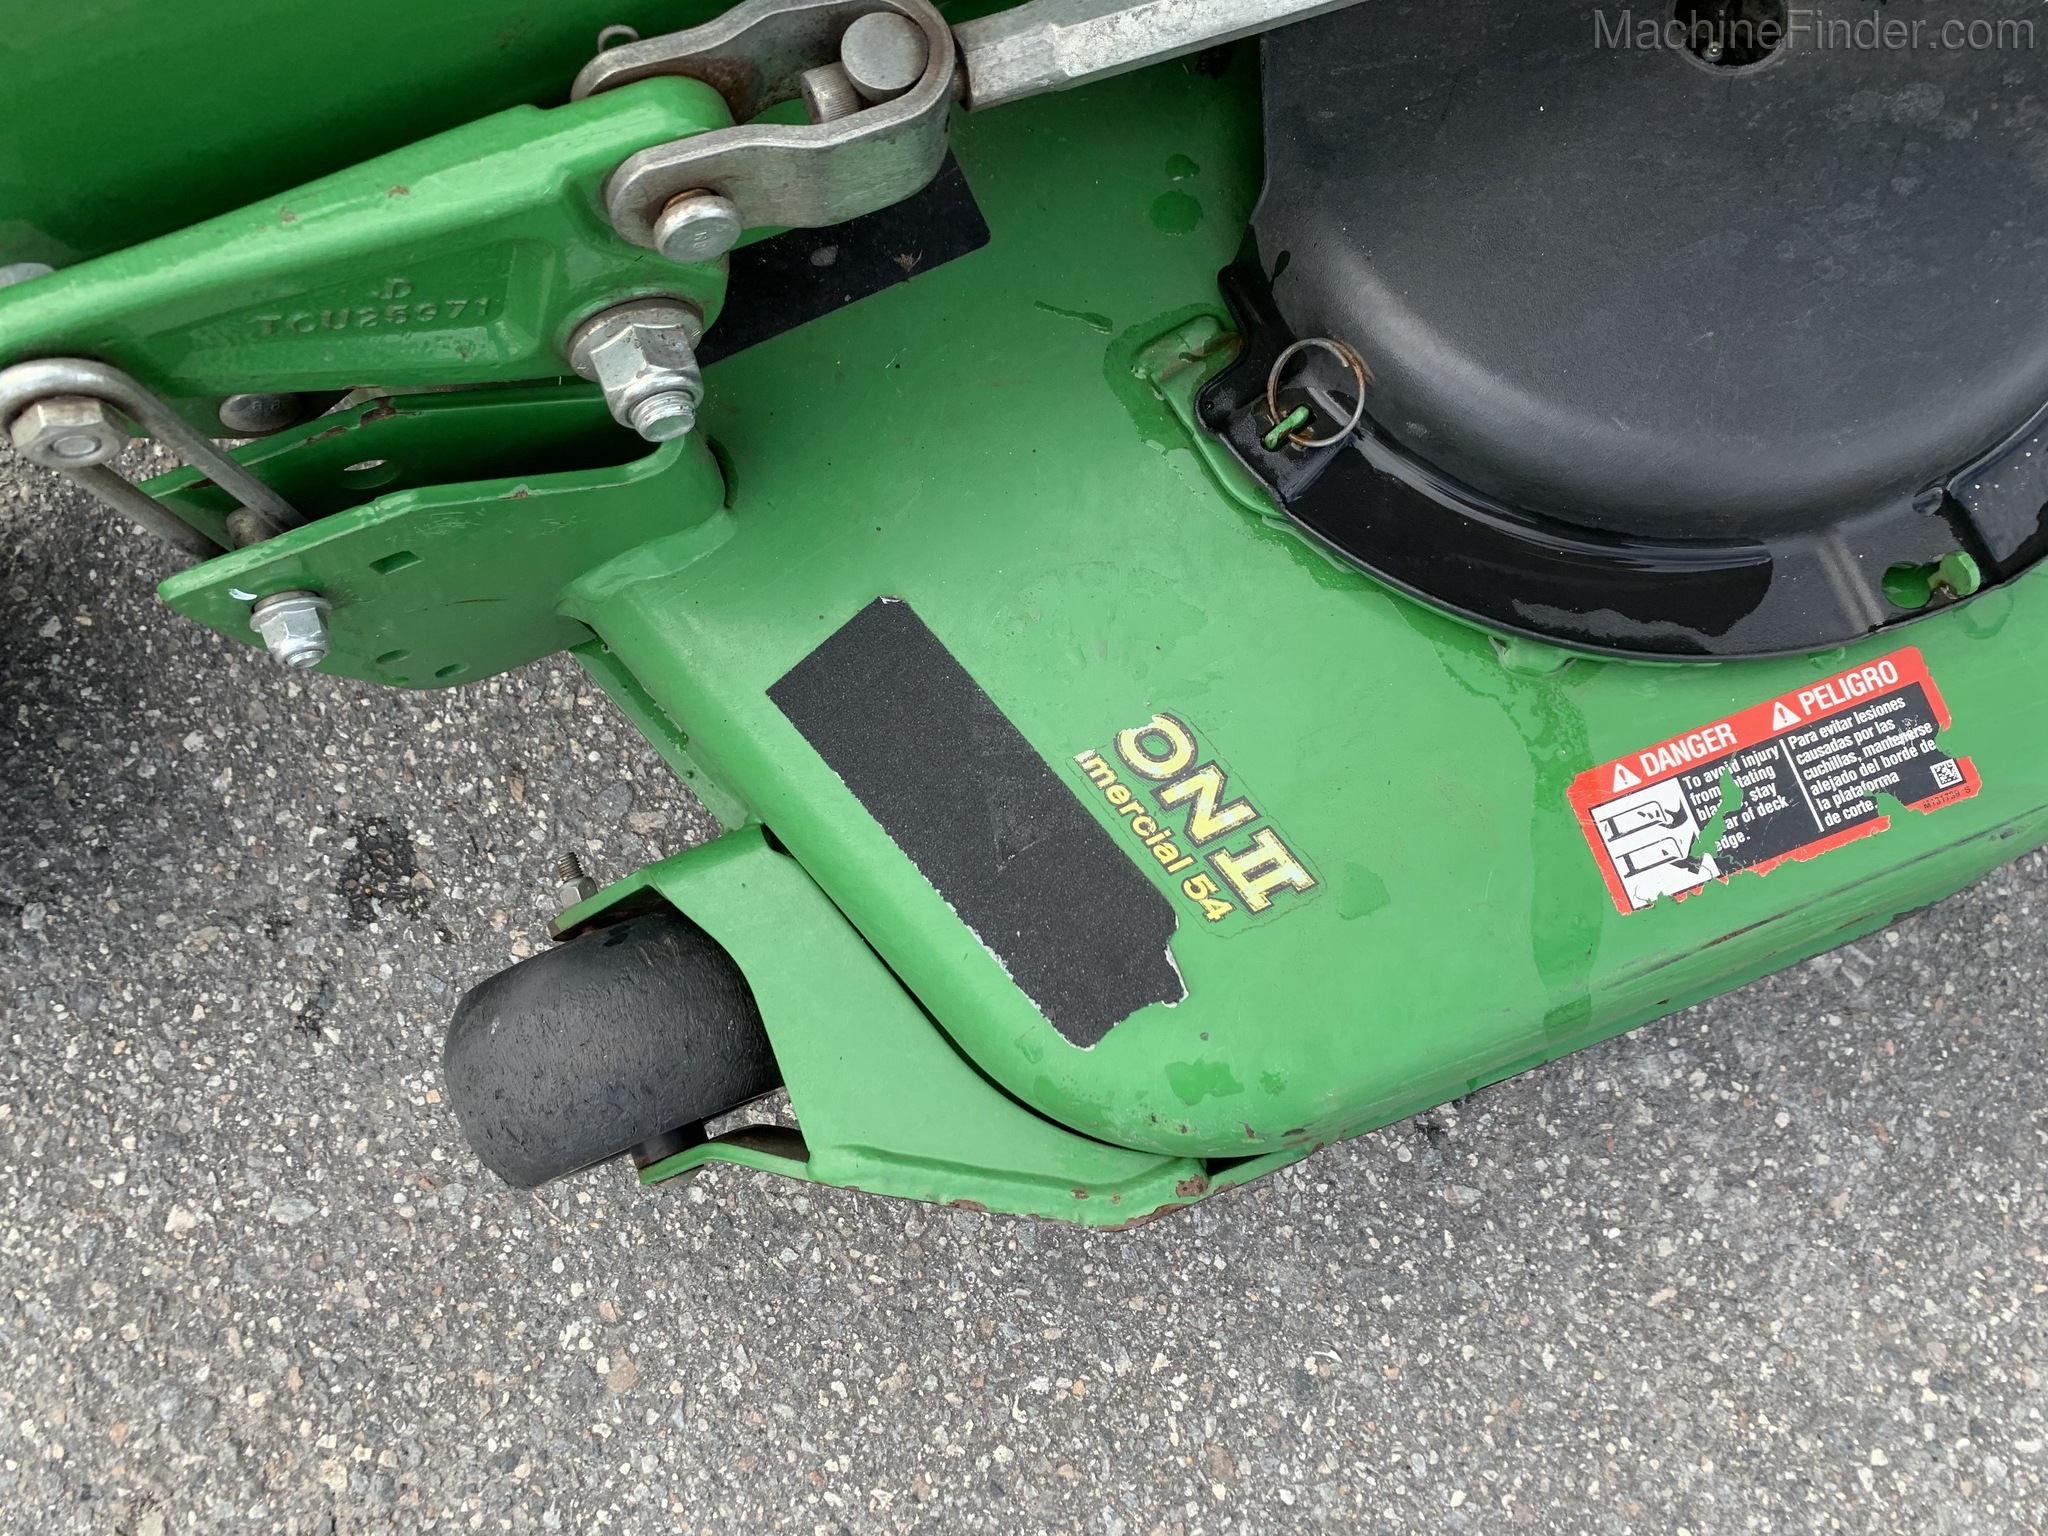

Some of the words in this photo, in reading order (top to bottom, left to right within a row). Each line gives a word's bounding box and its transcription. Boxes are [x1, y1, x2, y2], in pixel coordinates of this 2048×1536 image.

[1798, 659, 1899, 716] PELIGRO
[1787, 729, 1819, 750] Para
[1819, 716, 1853, 738] evitar
[1853, 696, 1906, 725] lesiones
[1795, 737, 1853, 766] causadas
[1853, 726, 1874, 746] por
[1874, 718, 1896, 735] las
[1639, 722, 1738, 777] DANGER
[1682, 775, 1702, 790] To
[1740, 745, 1780, 769] injury
[1803, 750, 1862, 781] cuchillas,
[1862, 722, 1933, 758] mantenerse
[1810, 769, 1858, 796] alejado
[1859, 758, 1881, 777] del
[1880, 745, 1919, 769] borde
[1919, 738, 1937, 754] de
[1690, 786, 1722, 806] from
[1741, 806, 1756, 823] of
[1757, 795, 1789, 817] deck
[1749, 782, 1777, 802] stay
[1816, 797, 1832, 812] la
[1832, 771, 1900, 809] plataforma
[1824, 812, 1841, 827] de
[1842, 799, 1878, 820] corte.
[1181, 870, 1237, 923] 54
